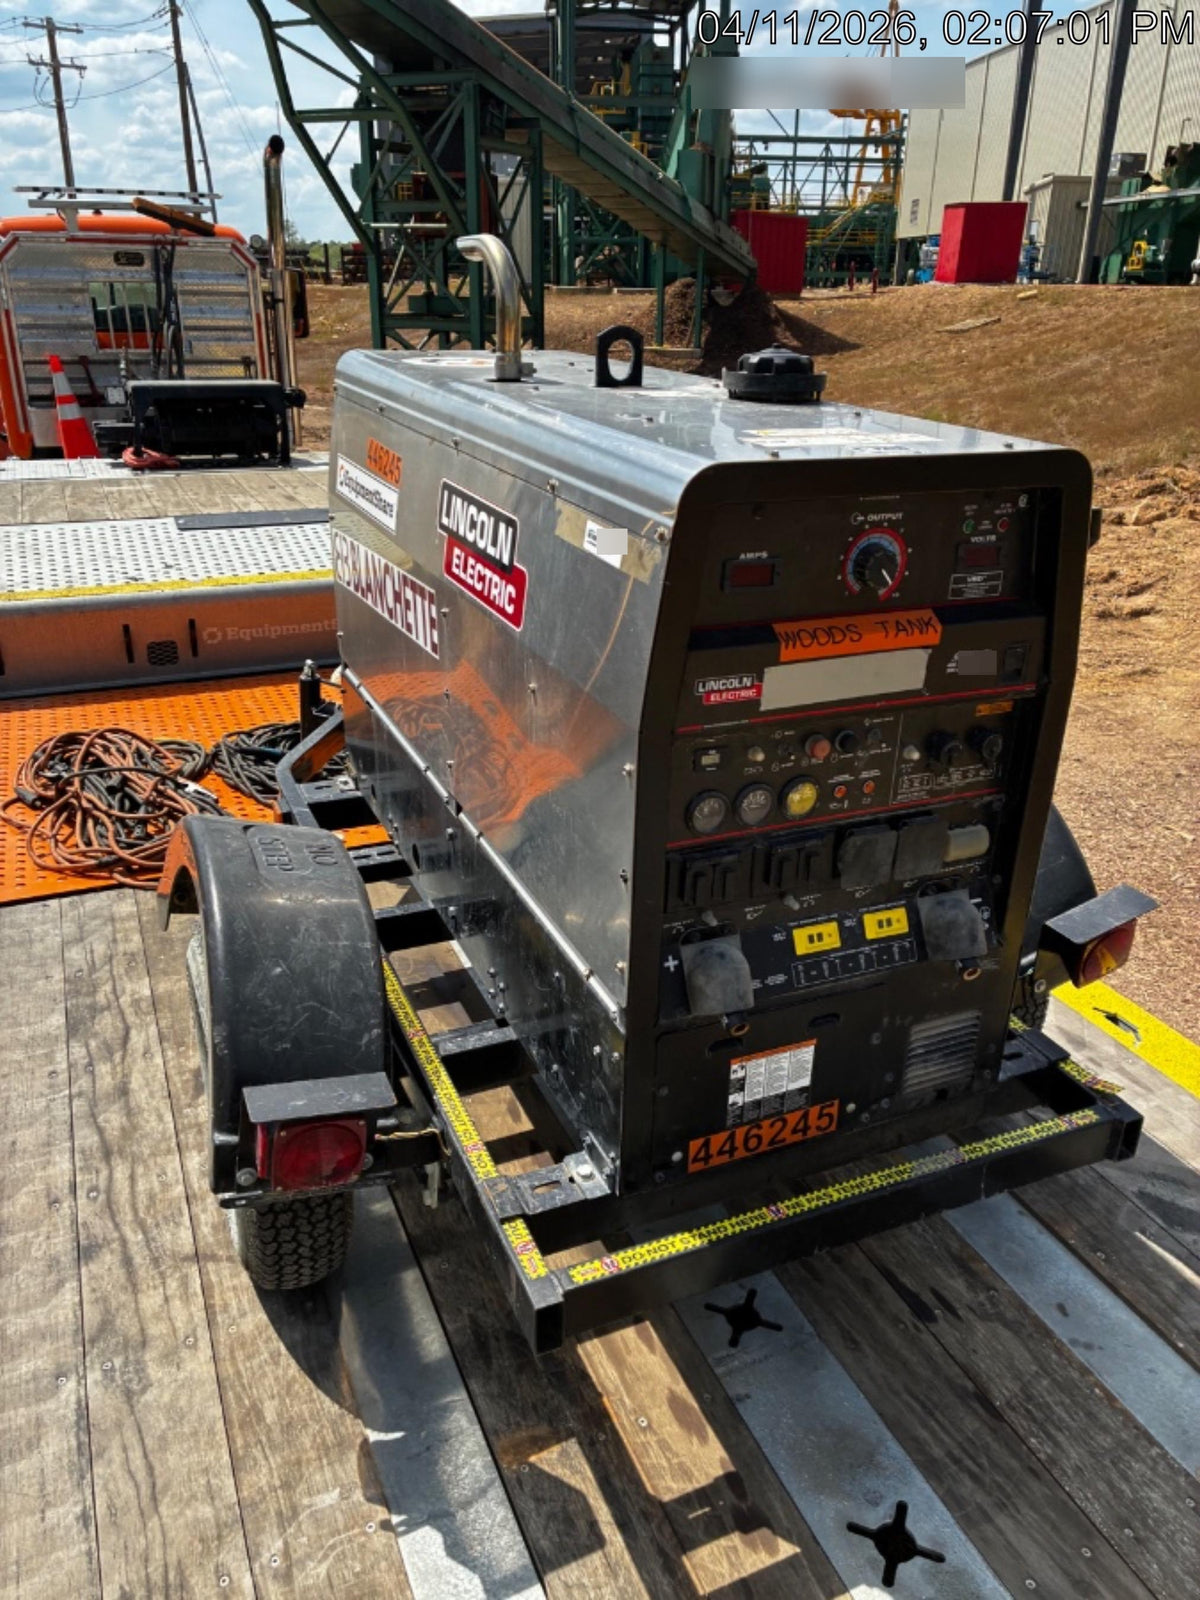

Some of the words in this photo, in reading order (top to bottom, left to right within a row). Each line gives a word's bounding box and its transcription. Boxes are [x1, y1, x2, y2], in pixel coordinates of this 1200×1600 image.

[367, 438, 402, 486] 446245
[440, 488, 513, 567] LINCOLN
[866, 512, 903, 522] OUTPUT
[738, 550, 769, 561] AMPS
[451, 546, 517, 615] ELECTRIC
[779, 624, 863, 650] WOODS
[874, 616, 939, 638] TANK
[697, 676, 753, 693] LINCOLN
[710, 688, 758, 702] ELECTRIC
[690, 1101, 836, 1167] 446245
[620, 1250, 645, 1266] DO
[646, 1239, 677, 1257] NOT
